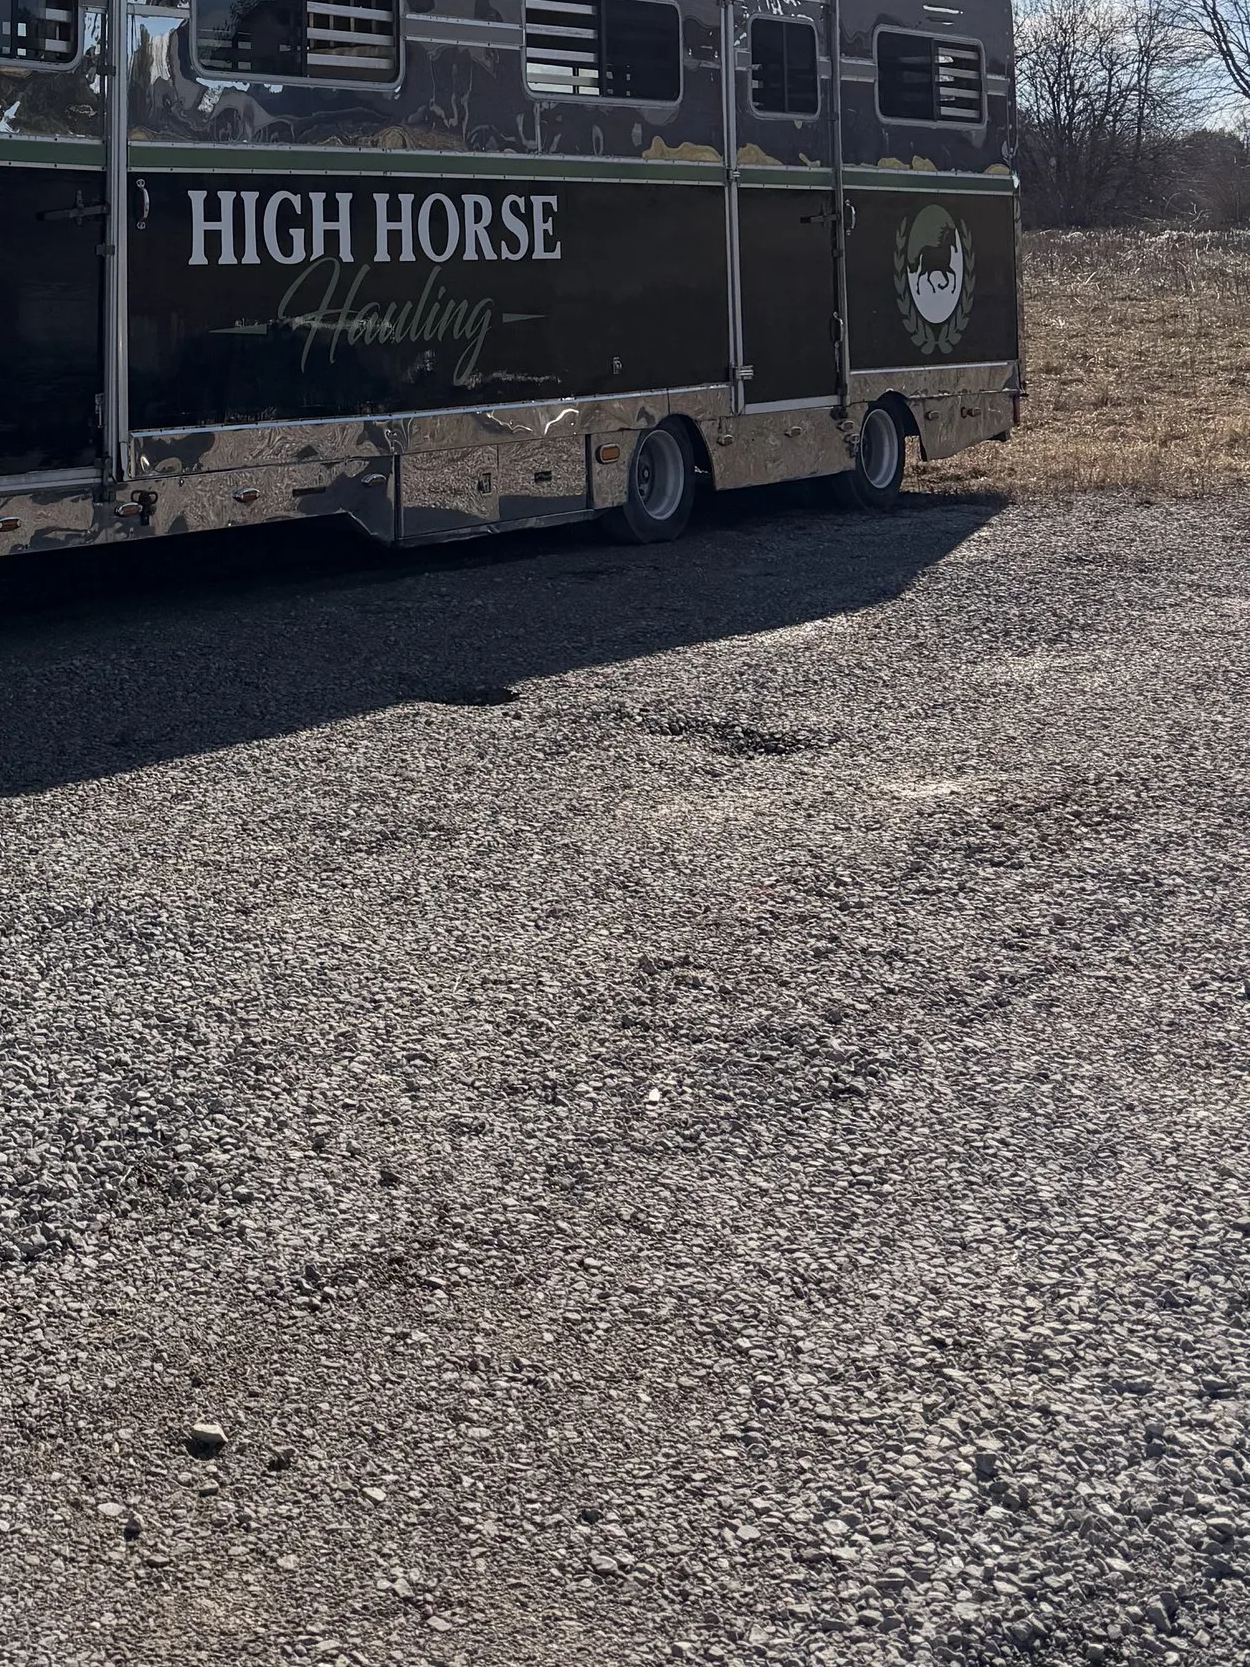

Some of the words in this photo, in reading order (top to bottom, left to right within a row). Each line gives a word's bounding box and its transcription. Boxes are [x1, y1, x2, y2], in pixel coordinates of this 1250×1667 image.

[187, 190, 355, 265] HIGH
[373, 192, 562, 263] HORSE
[277, 256, 495, 386] Hauling
